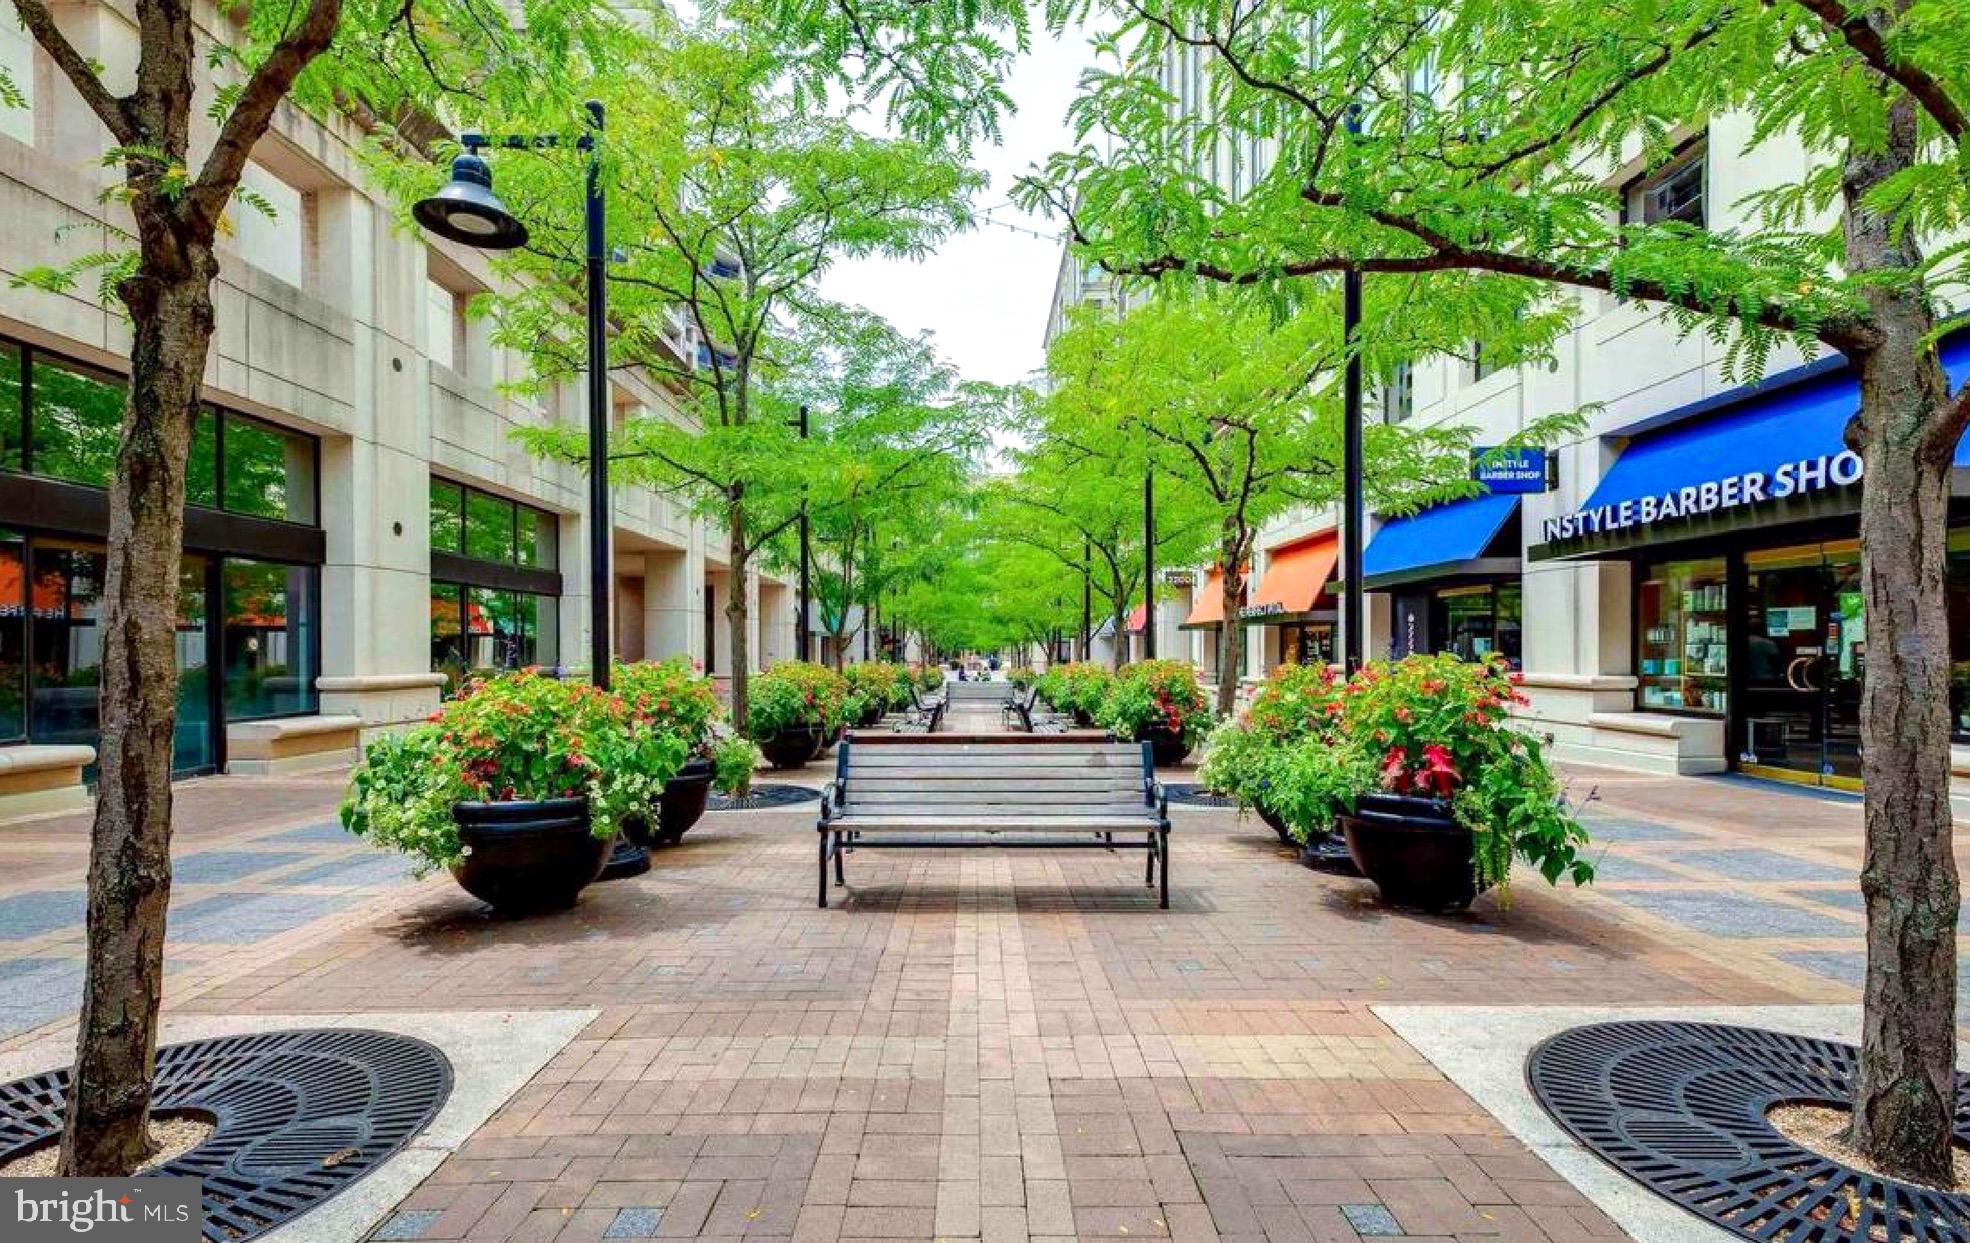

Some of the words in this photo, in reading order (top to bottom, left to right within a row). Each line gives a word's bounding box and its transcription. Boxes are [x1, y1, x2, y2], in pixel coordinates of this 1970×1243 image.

[1516, 470, 1542, 480] SHOP
[1542, 500, 1636, 542] INSTYLE
[1641, 472, 1767, 525] BARBER
[1773, 450, 1864, 498] SHO
